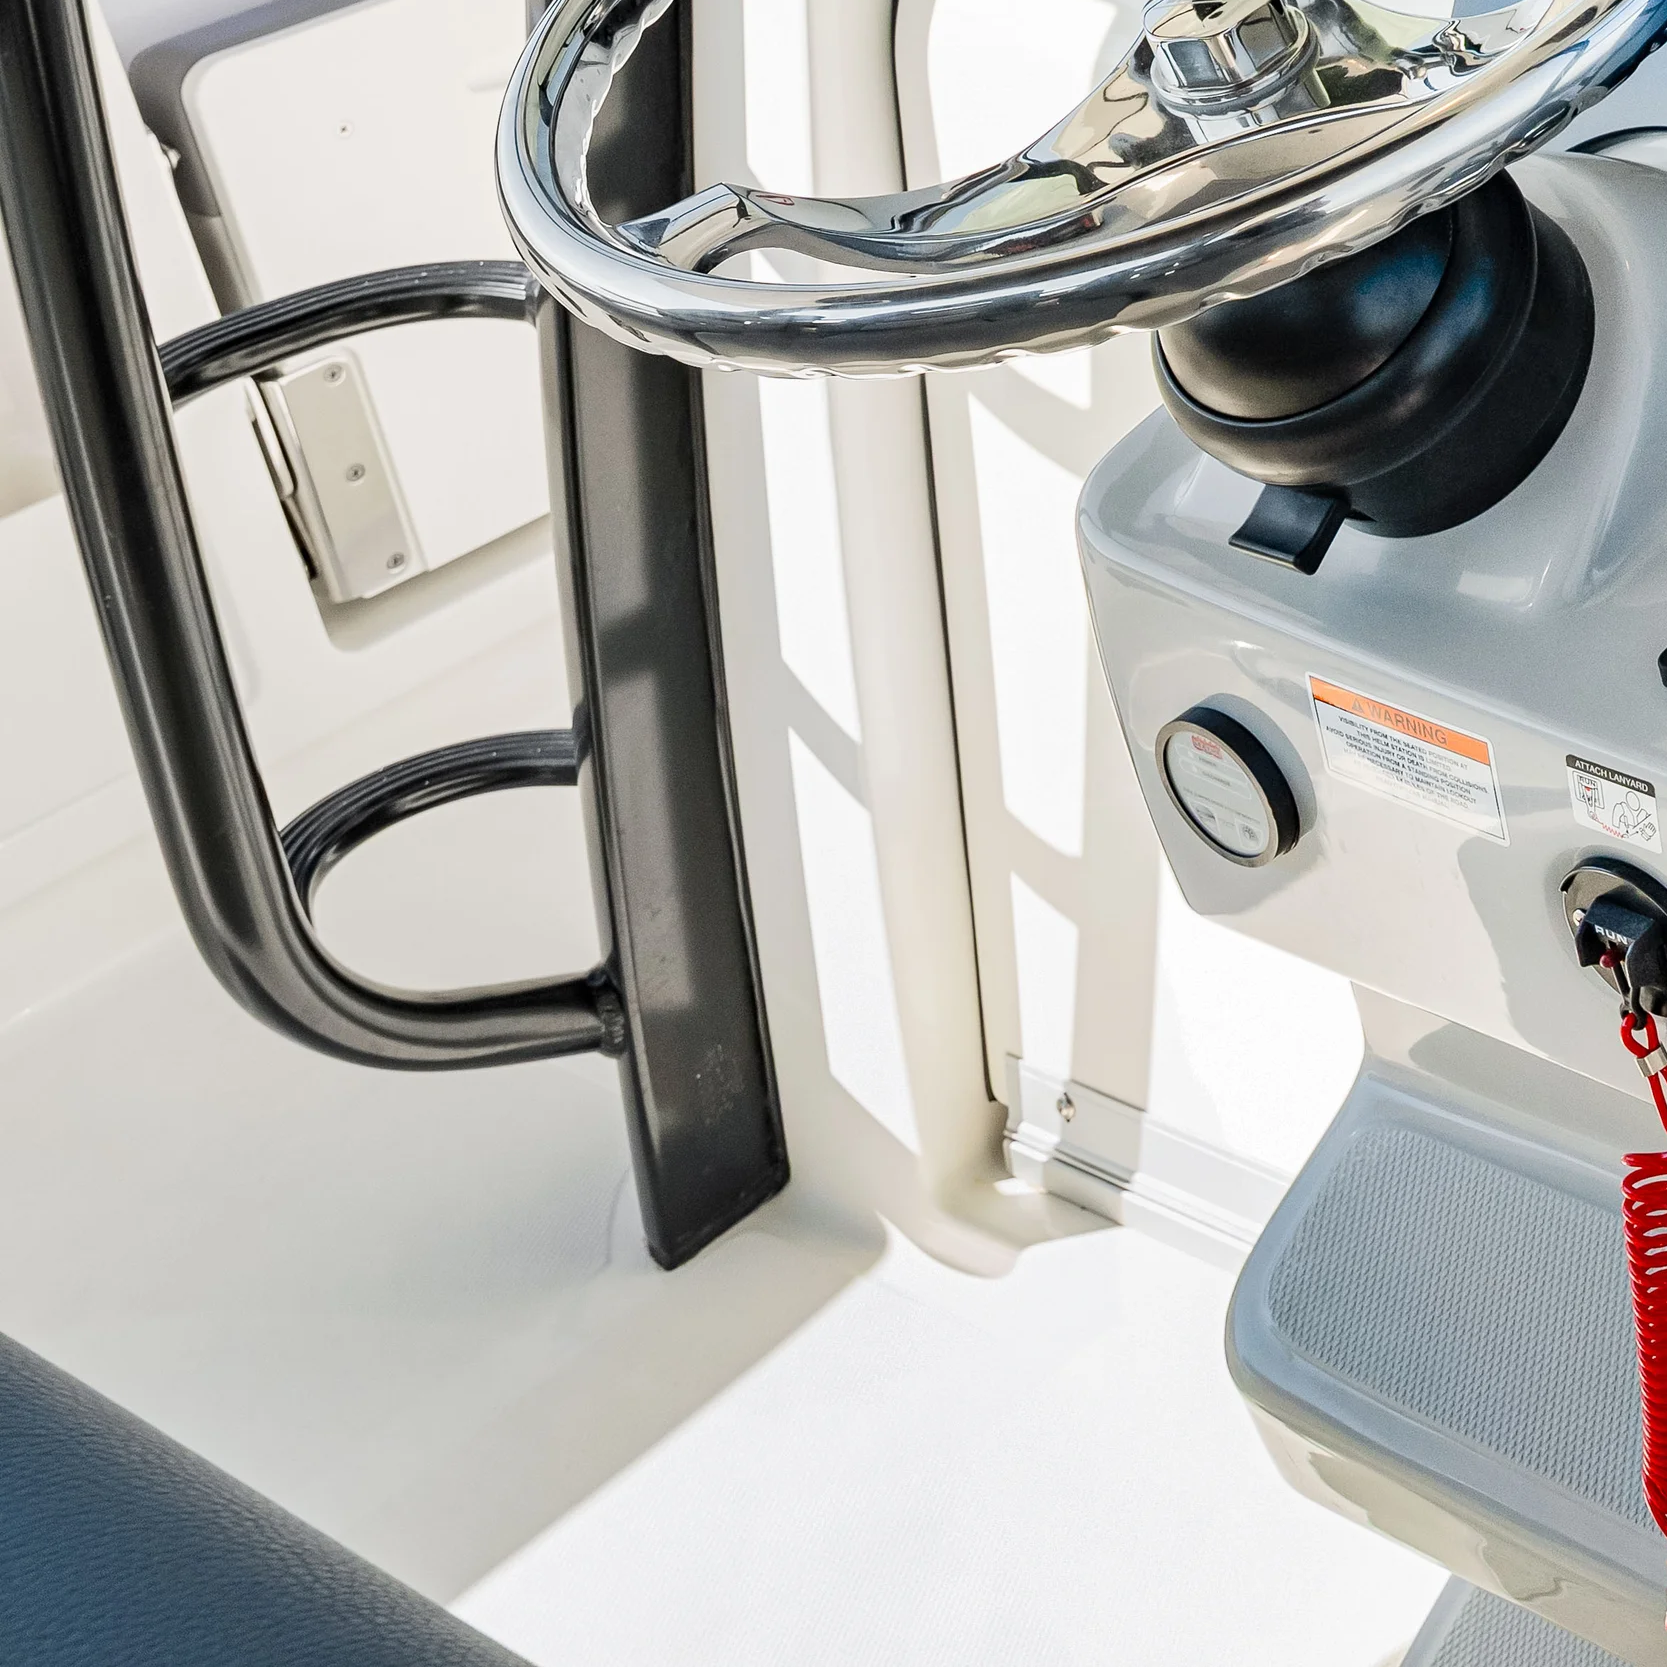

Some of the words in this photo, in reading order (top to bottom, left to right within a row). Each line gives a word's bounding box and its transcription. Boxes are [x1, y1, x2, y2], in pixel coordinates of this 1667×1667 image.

[1368, 703, 1448, 745] WARNING
[1575, 759, 1607, 778] ATTACH
[1607, 771, 1649, 793] LANYARD
[1594, 924, 1628, 944] RUN
